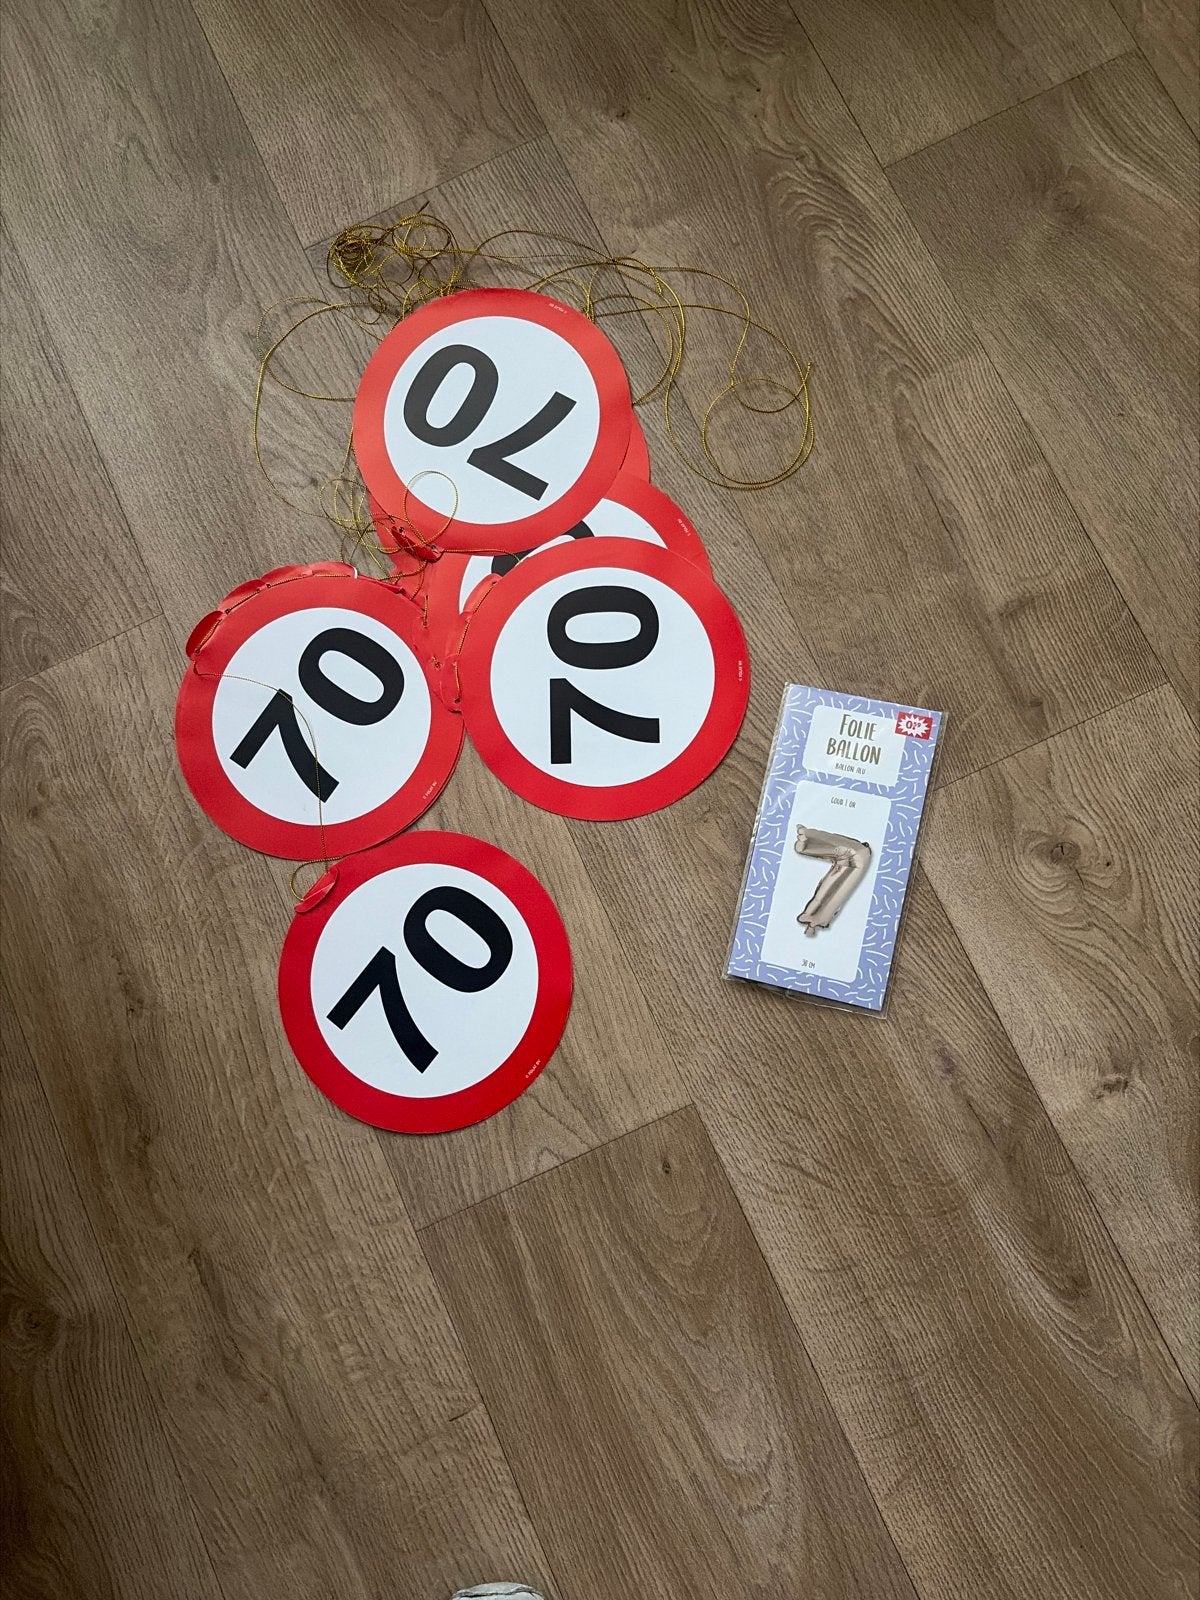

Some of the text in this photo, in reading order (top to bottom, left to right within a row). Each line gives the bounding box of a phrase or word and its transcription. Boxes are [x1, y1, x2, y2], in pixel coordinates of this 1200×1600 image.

[404, 345, 576, 500] 70
[230, 628, 404, 803] 70
[547, 586, 660, 764] 70
[826, 737, 882, 765] BALLON
[839, 714, 877, 741] FOLIE
[835, 762, 866, 775] BALLON ALU
[327, 886, 513, 1073] 70
